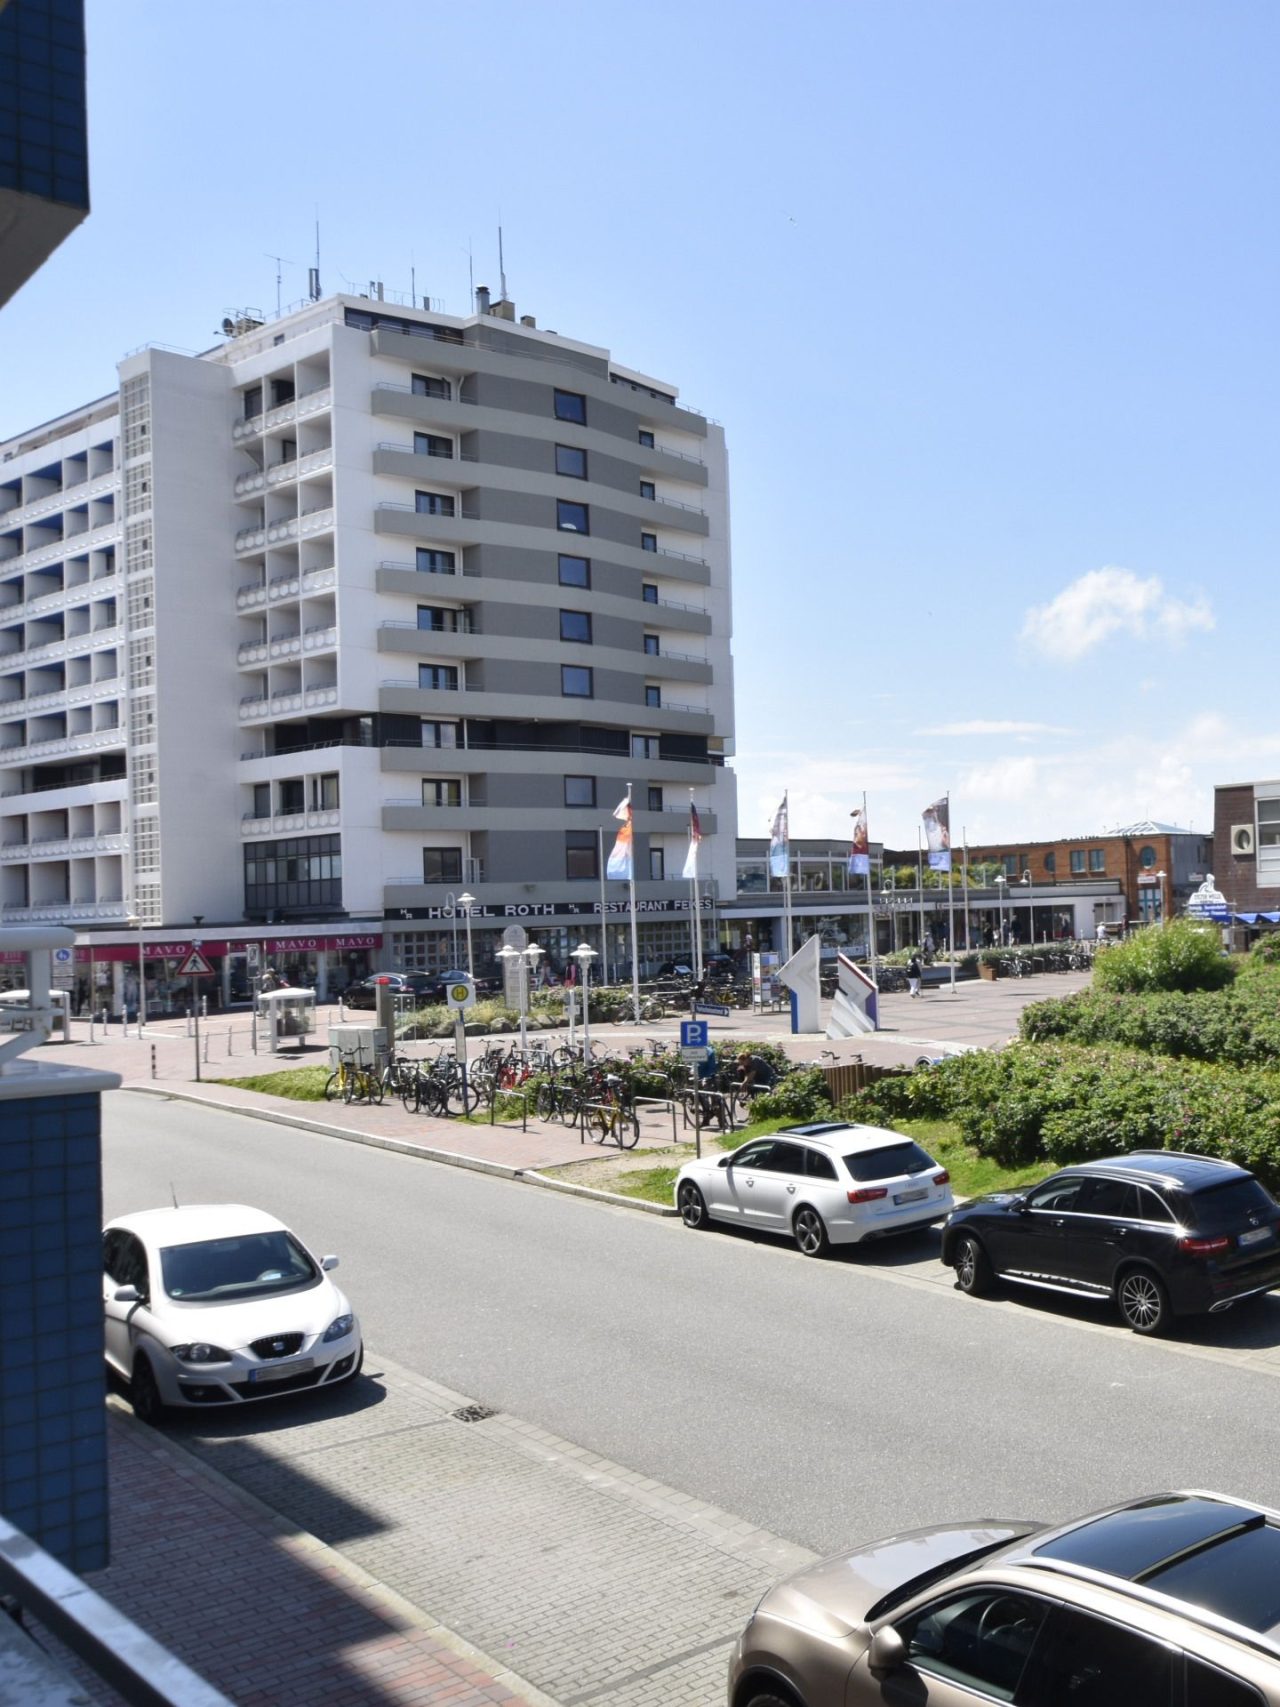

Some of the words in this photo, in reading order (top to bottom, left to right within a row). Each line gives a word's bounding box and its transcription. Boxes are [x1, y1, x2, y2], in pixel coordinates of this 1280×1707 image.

[428, 905, 496, 919] HOTEL
[504, 904, 555, 916] ROTH
[593, 901, 669, 913] RESTAURANT
[275, 939, 317, 949] MAVO
[335, 937, 375, 946] MAVO
[142, 945, 186, 955] MAVO
[686, 1024, 702, 1044] P
